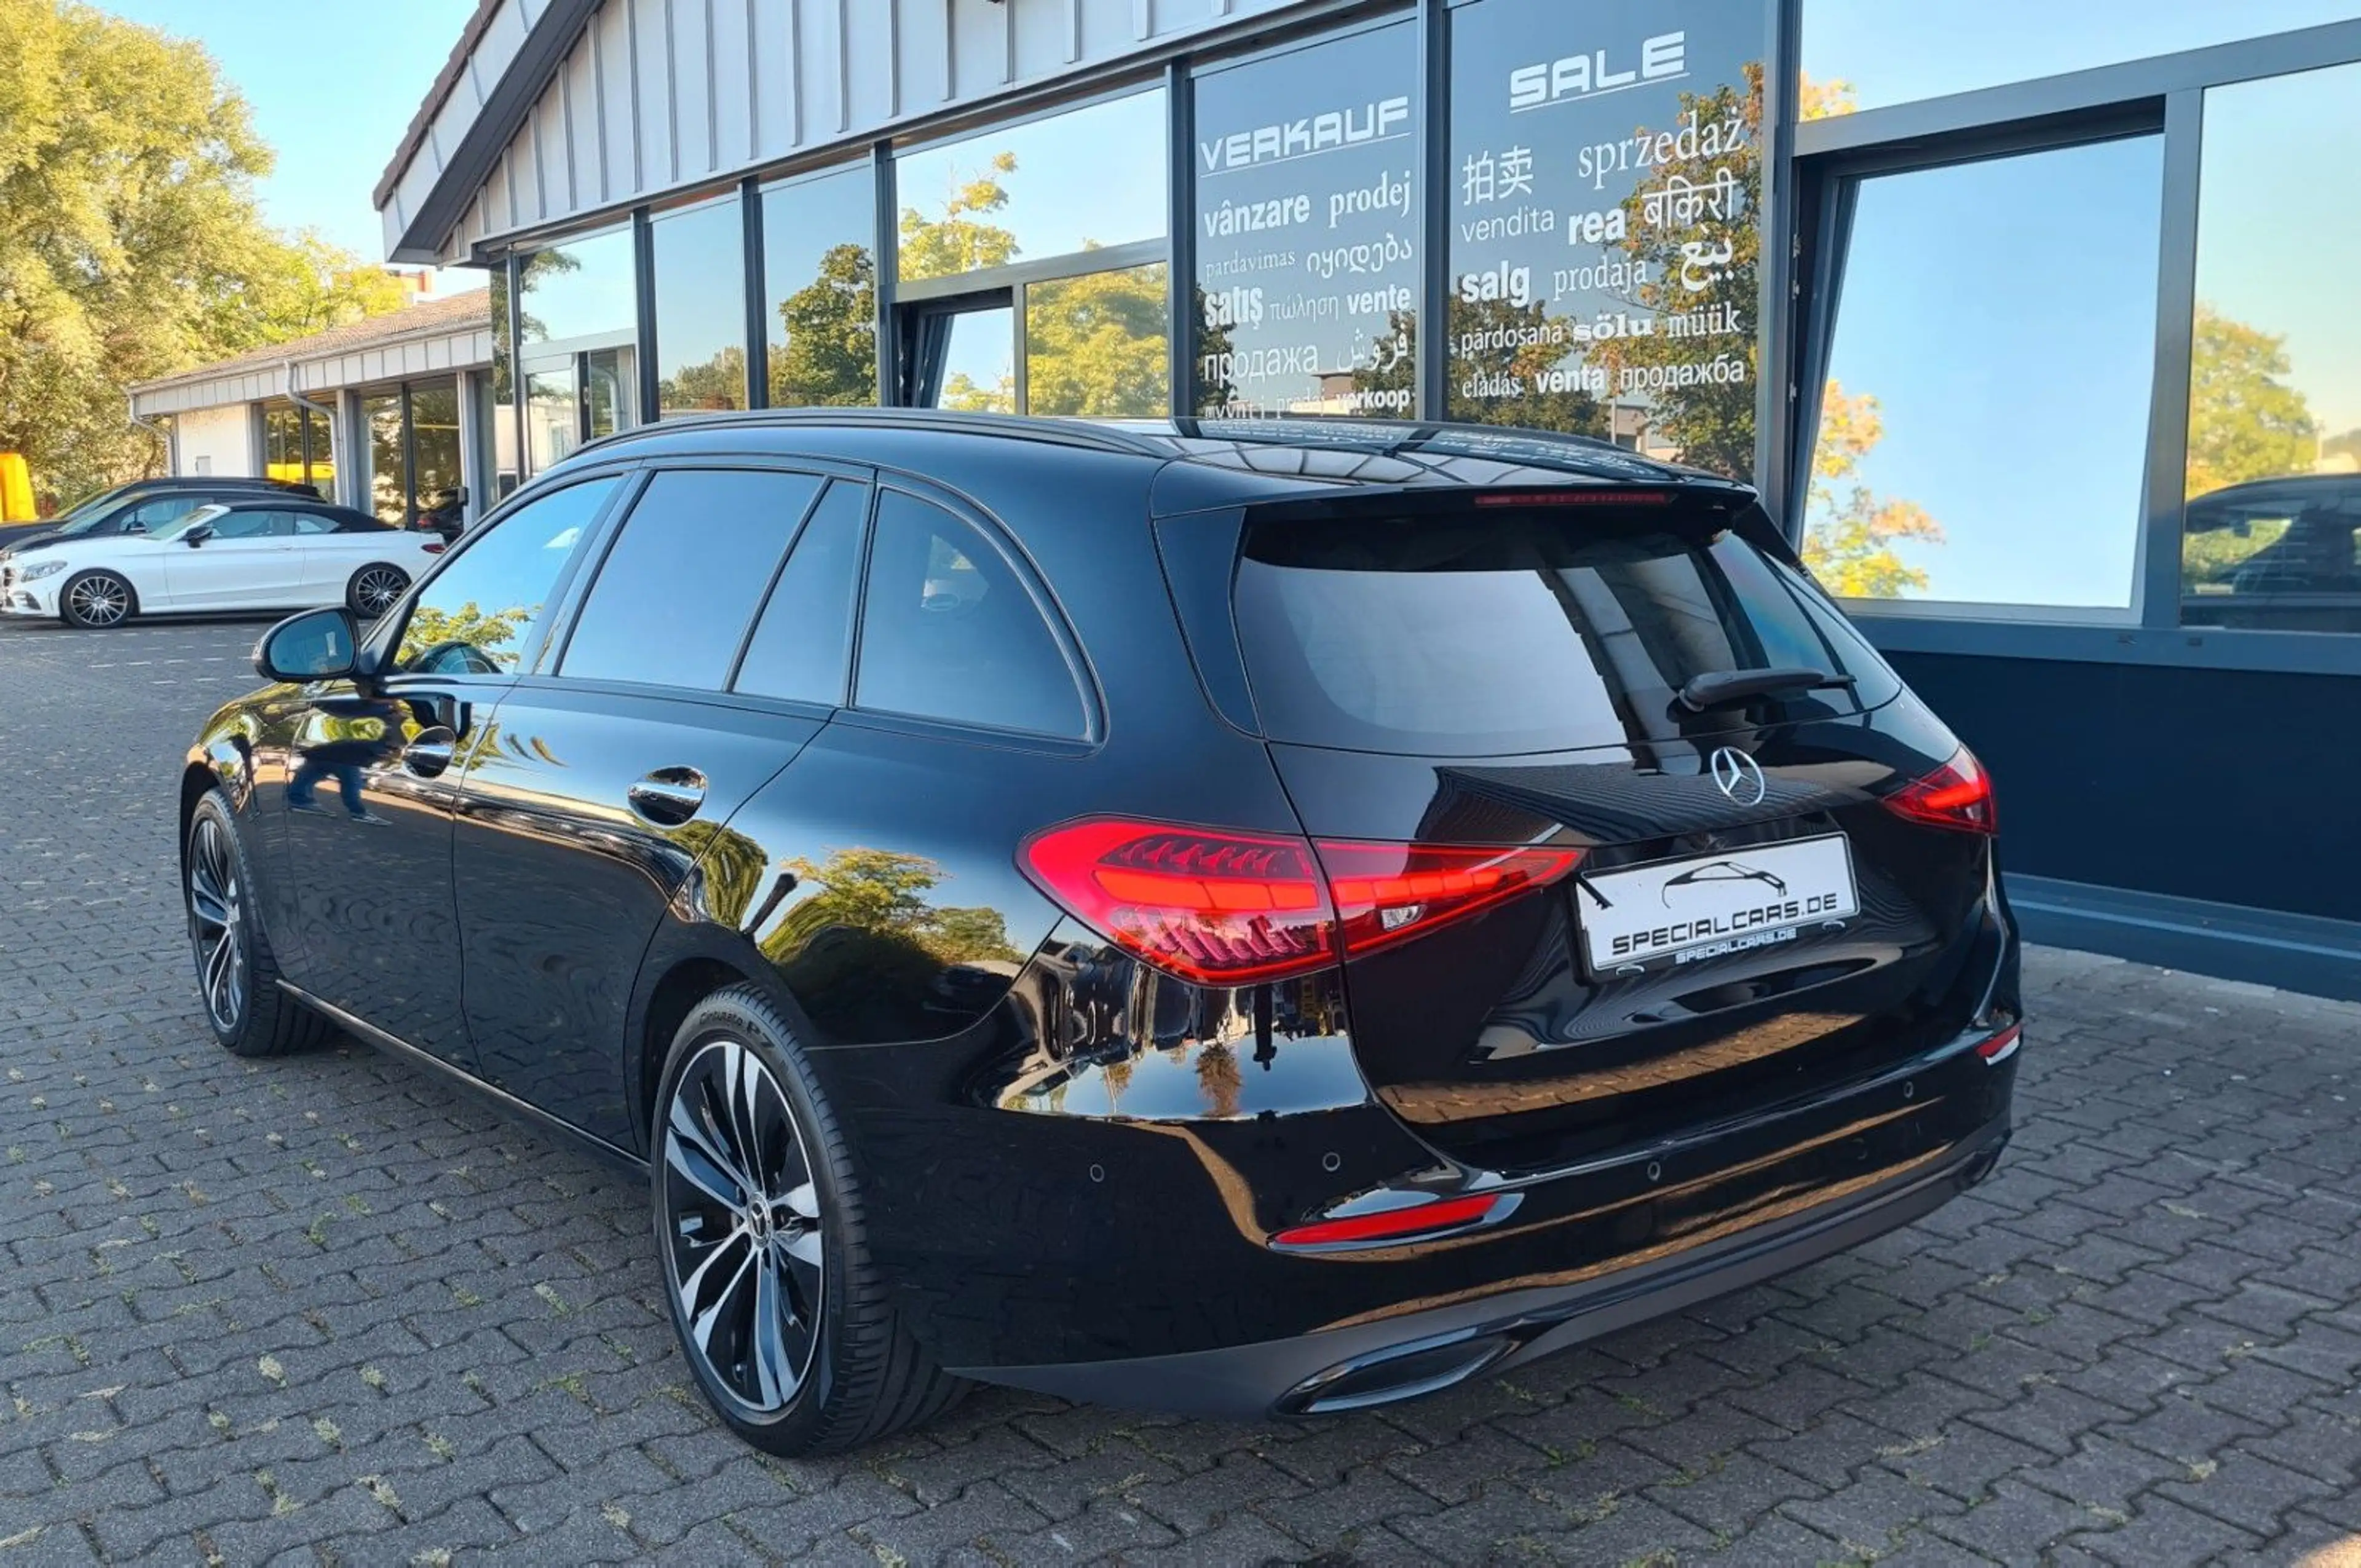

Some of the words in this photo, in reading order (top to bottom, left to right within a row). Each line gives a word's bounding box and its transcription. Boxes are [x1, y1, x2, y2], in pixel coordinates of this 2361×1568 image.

[1510, 31, 1685, 107] SALE
[1200, 96, 1409, 171] VERKAUF
[1578, 106, 1745, 190] sprzedaż
[1461, 144, 1534, 206] 拍卖
[1204, 192, 1310, 237] vânzare
[1329, 170, 1411, 229] prodej
[1461, 207, 1555, 243] vendita
[1568, 208, 1626, 245] rea
[1206, 250, 1295, 284] pardavimas
[1461, 260, 1530, 307] salg
[1554, 252, 1648, 302] prodaja
[1205, 285, 1264, 329] satış
[1270, 294, 1339, 323] πώληση
[1347, 284, 1410, 315] vente
[1337, 323, 1408, 373] فروش
[1461, 320, 1563, 358] pārdošana
[1573, 313, 1655, 341] sölu
[1667, 301, 1742, 338] müük
[1204, 344, 1318, 388] продажа
[1461, 370, 1522, 398] eladás
[1535, 364, 1606, 393] venta
[1620, 353, 1745, 394] продажба
[1337, 388, 1410, 412] verkoop
[1612, 892, 1838, 956] SPECIALCARS.DE
[1675, 928, 1798, 965] SPECIALCARS.DE
